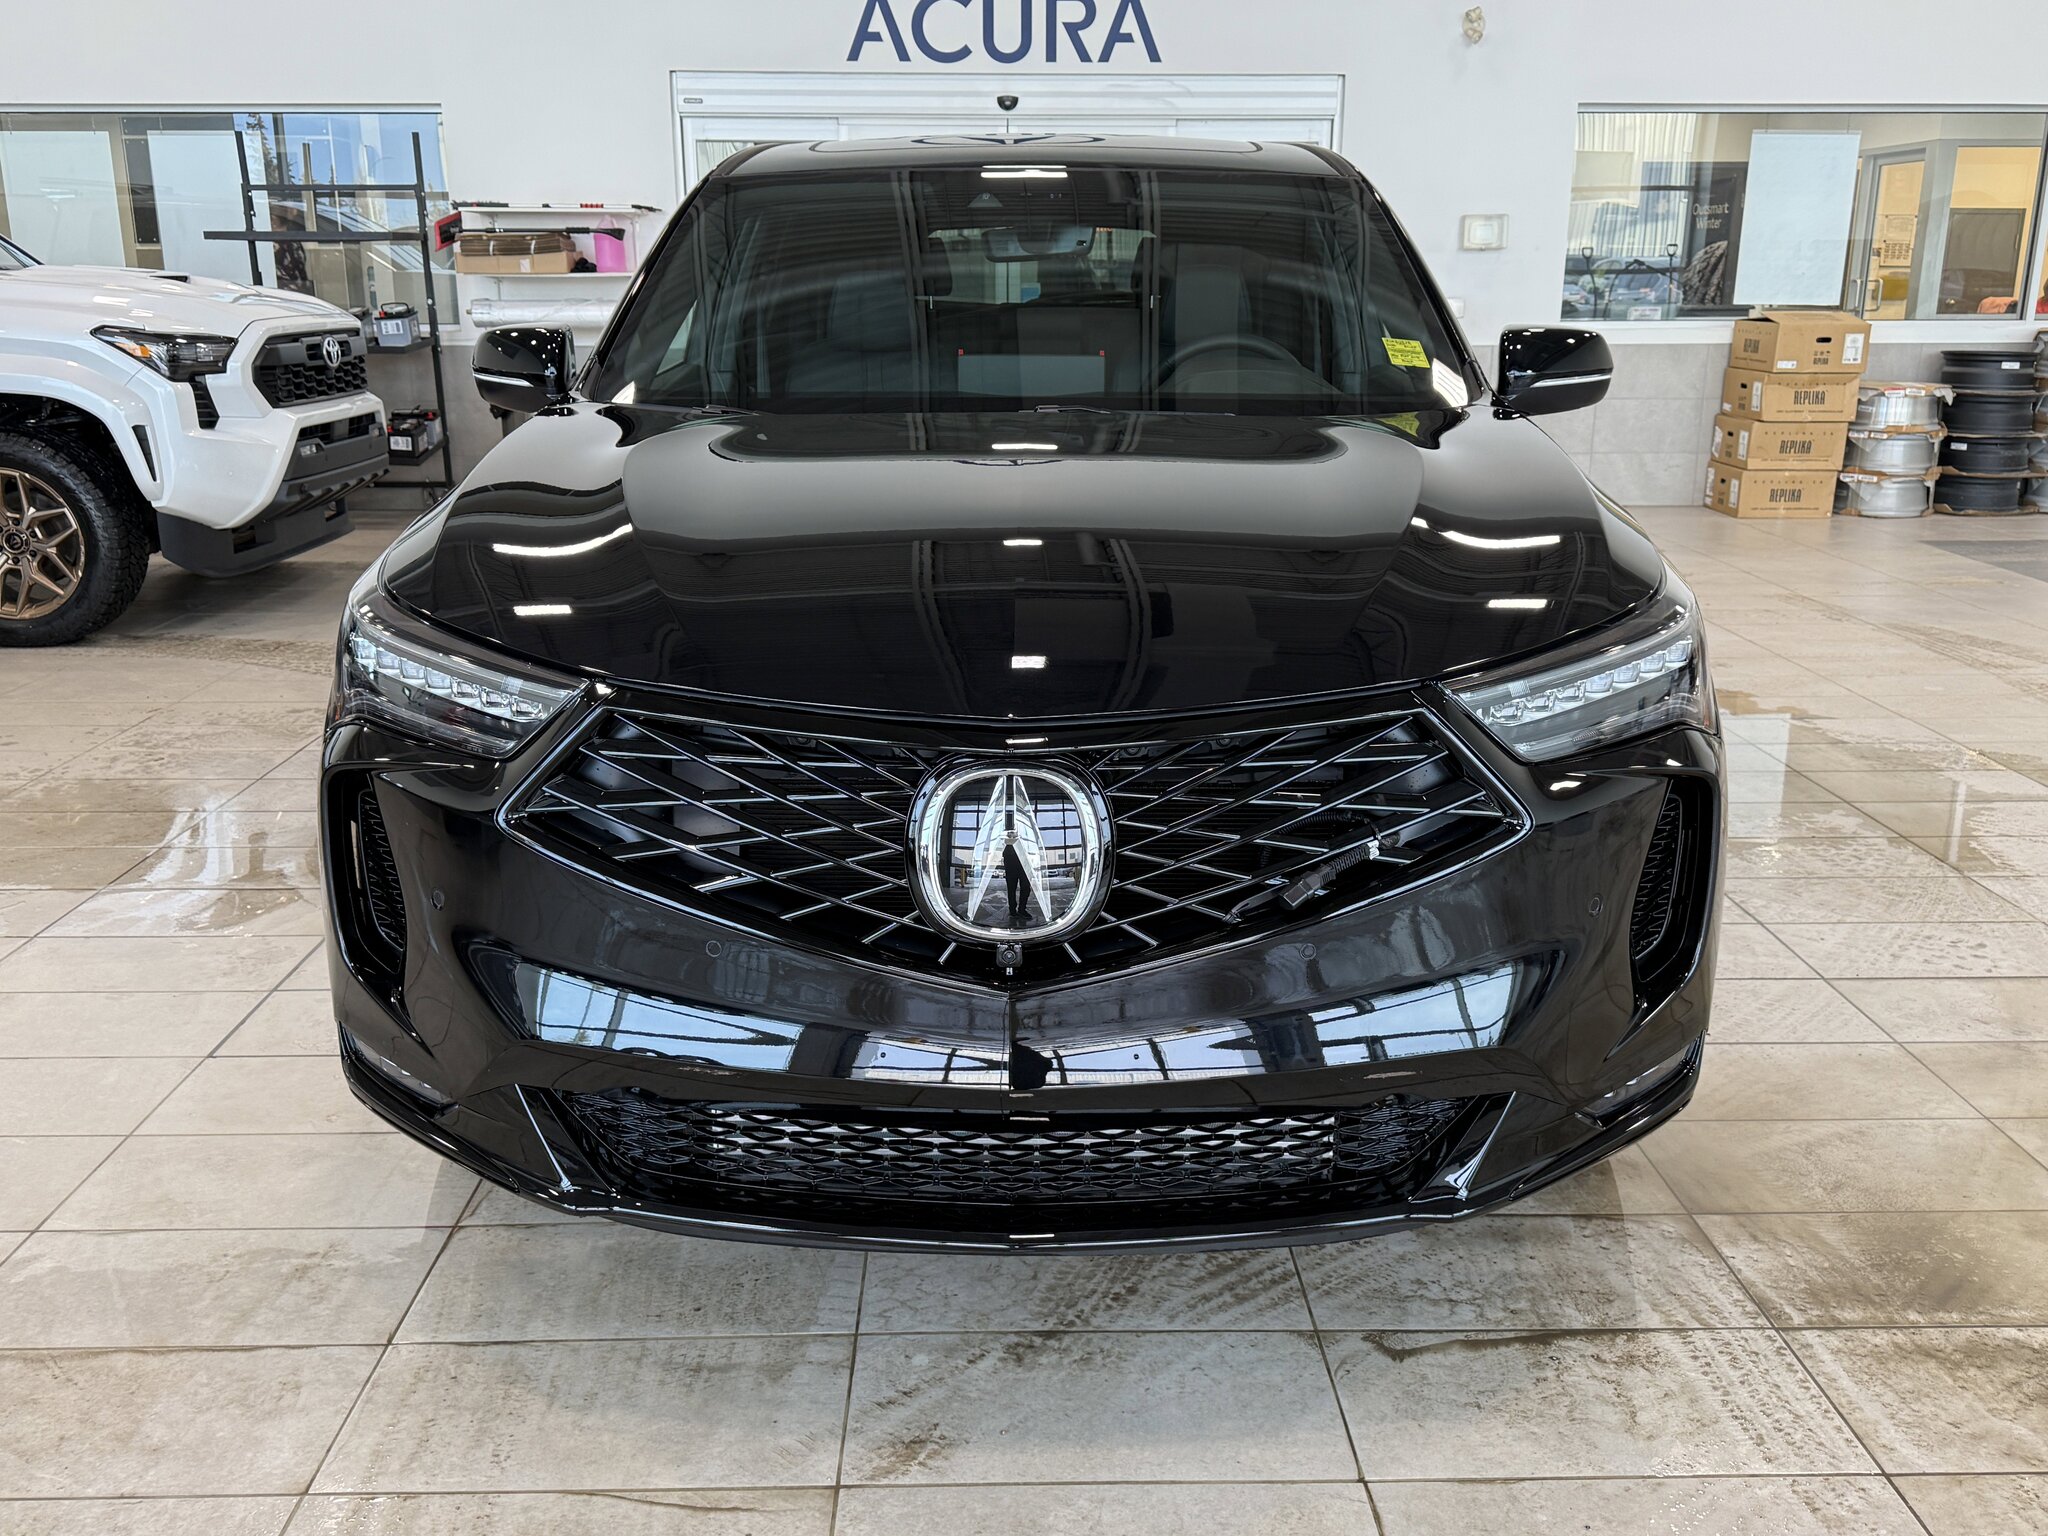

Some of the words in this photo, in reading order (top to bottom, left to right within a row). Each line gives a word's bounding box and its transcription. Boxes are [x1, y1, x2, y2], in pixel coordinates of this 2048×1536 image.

[846, 0, 1162, 63] ACURA
[1693, 202, 1729, 215] Outsmart
[1696, 217, 1722, 229] Winter
[1794, 390, 1826, 406] REPLIKA
[1779, 440, 1813, 454] REPLIKA
[1769, 488, 1802, 503] REPLIKA
